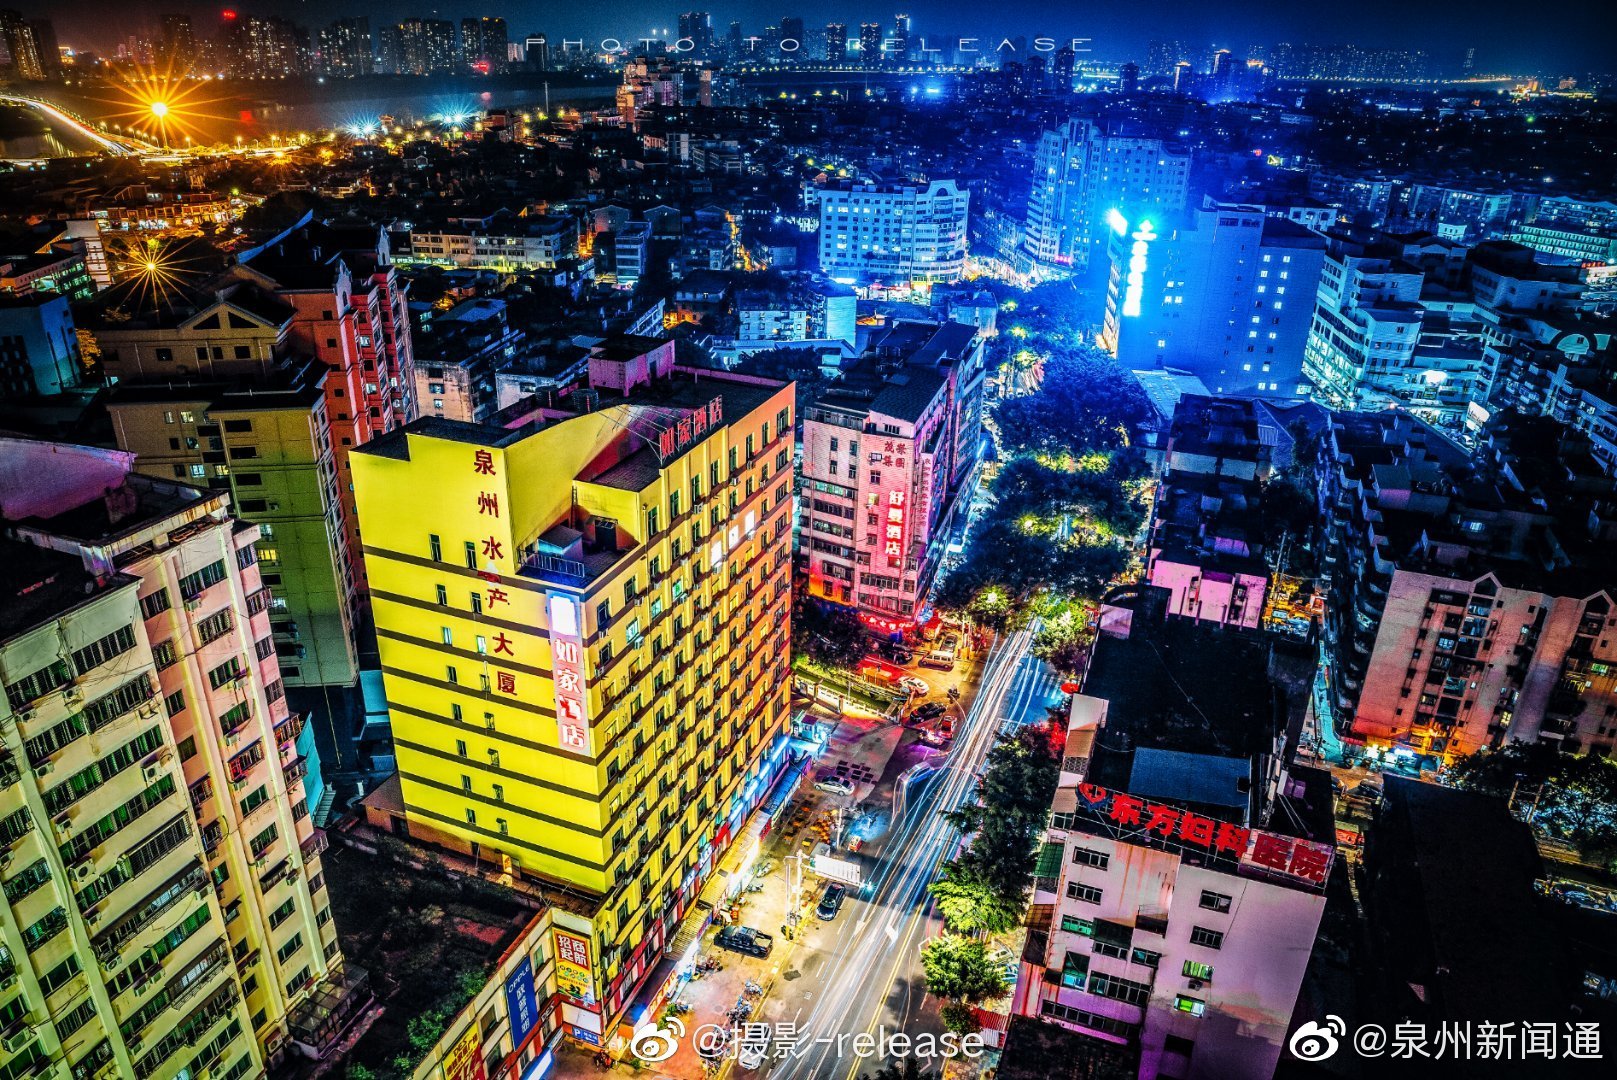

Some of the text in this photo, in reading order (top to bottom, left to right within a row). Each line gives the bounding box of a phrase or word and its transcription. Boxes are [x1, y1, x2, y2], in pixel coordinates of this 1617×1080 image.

[659, 395, 723, 459] 如家酒店
[885, 490, 904, 556] 舒曼酒店
[473, 449, 517, 696] 泉州水产大厦
[555, 638, 585, 748] 如家酒店
[1110, 794, 1331, 882] 东方妇科医院
[558, 934, 586, 955] 招商
[560, 947, 587, 966] 起航
[508, 963, 530, 993] OPPLE
